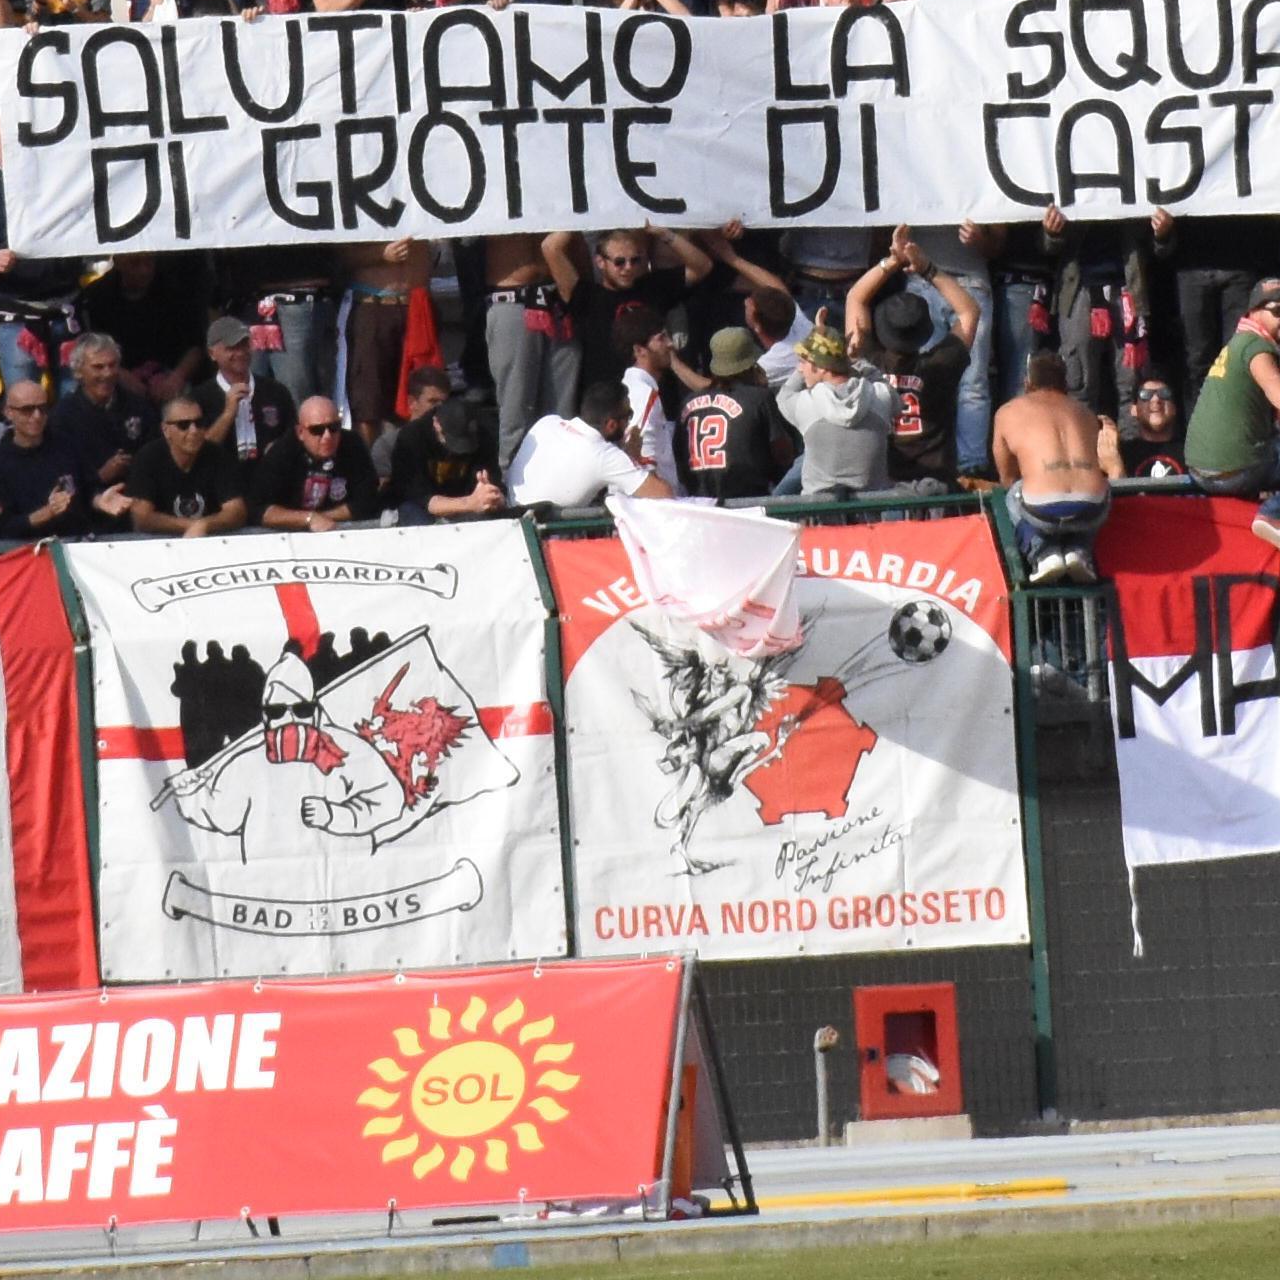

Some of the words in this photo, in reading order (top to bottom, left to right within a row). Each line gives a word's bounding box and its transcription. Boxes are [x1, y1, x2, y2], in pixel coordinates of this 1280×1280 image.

[16, 9, 692, 148] SALUTIAMO
[774, 3, 911, 99] LA
[91, 142, 191, 244] DI
[263, 109, 686, 230] GROTTE
[768, 103, 878, 218] DI
[687, 414, 728, 471] 12
[158, 566, 282, 597] VECCHIA
[291, 565, 426, 584] GUARDIA
[775, 807, 883, 879] Passione
[794, 824, 906, 892] Infinita
[232, 903, 293, 929] BAD
[342, 893, 422, 927] BOYS
[595, 900, 709, 939] CURVA
[721, 895, 817, 934] NORD
[828, 887, 1006, 930] GROSSETO
[420, 1072, 516, 1106] SOL
